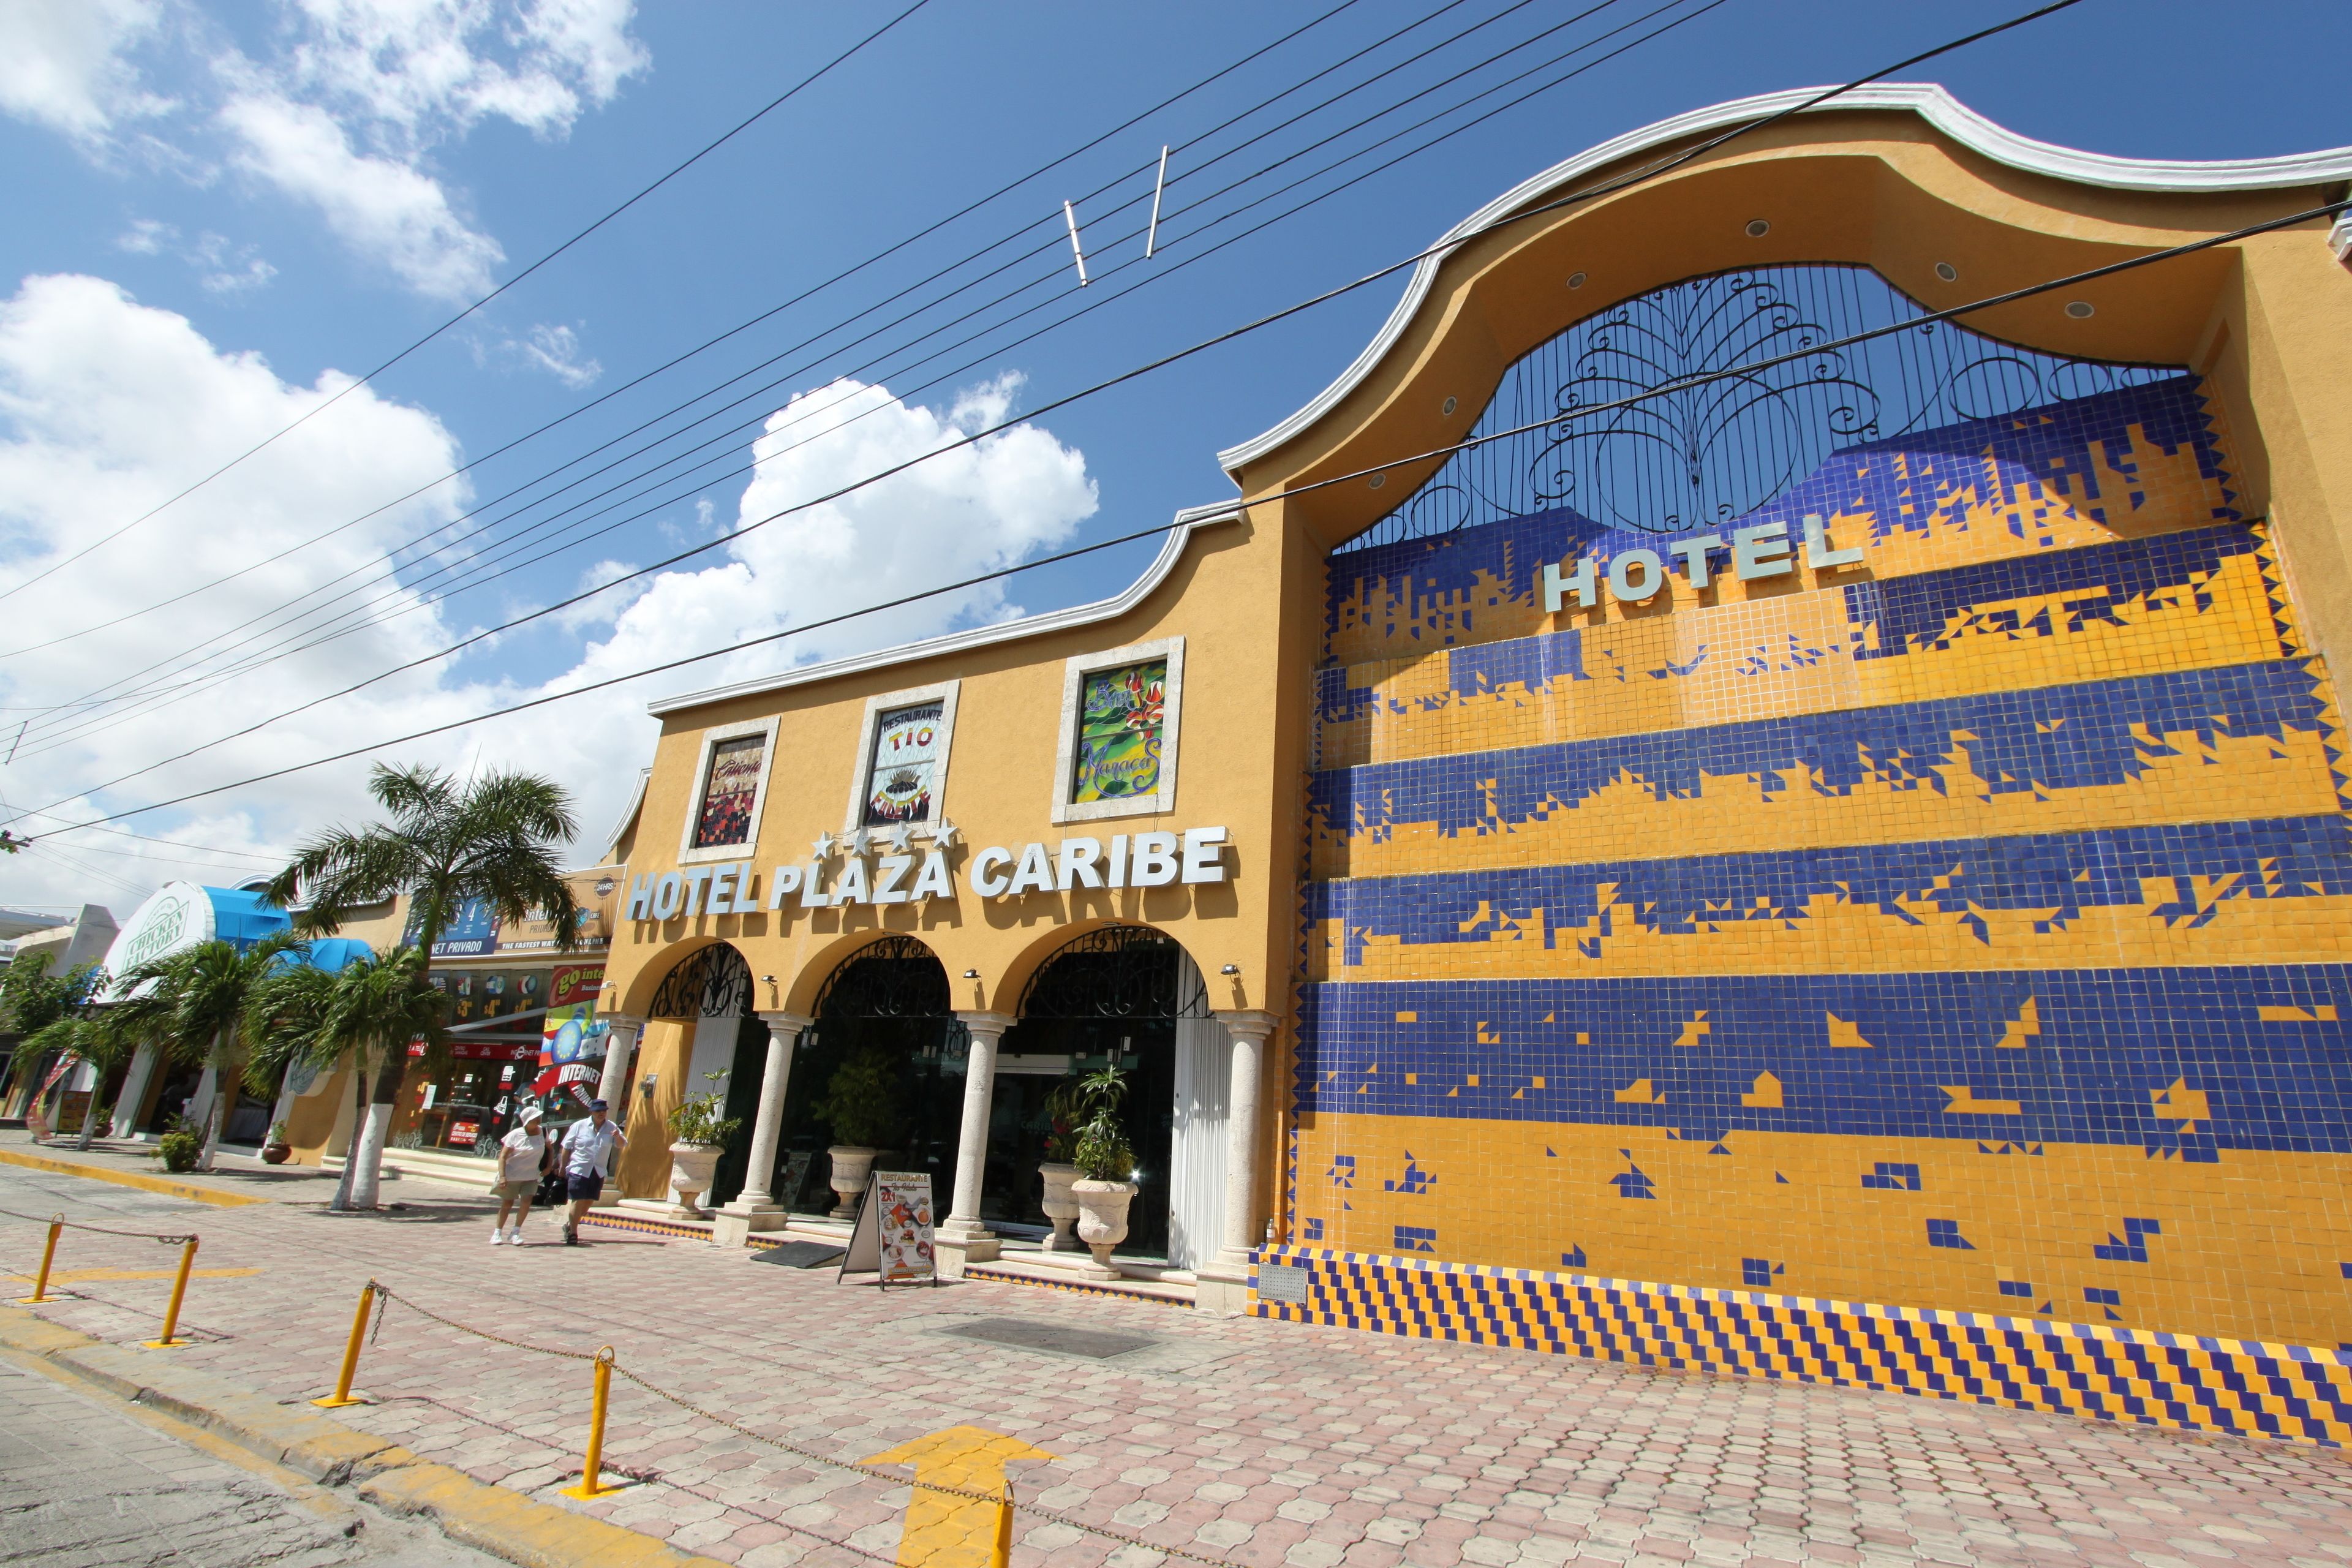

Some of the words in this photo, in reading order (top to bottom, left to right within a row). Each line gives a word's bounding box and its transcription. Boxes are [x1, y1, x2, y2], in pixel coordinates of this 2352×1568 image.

[1543, 514, 1864, 613] HOTEL
[883, 709, 943, 733] RESTAURANTE
[715, 759, 762, 781] Caliente
[870, 784, 930, 820] FILETE
[625, 862, 760, 921] HOTEL
[769, 851, 954, 910] PLAZA
[970, 826, 1228, 898] CARIBE
[130, 907, 184, 955] CHICKEN
[124, 921, 183, 970] FACTORY
[447, 941, 482, 953] PRIVADO
[559, 970, 581, 995] go
[558, 1064, 601, 1085] INTERNET
[881, 1174, 927, 1182] RESTAURANTE
